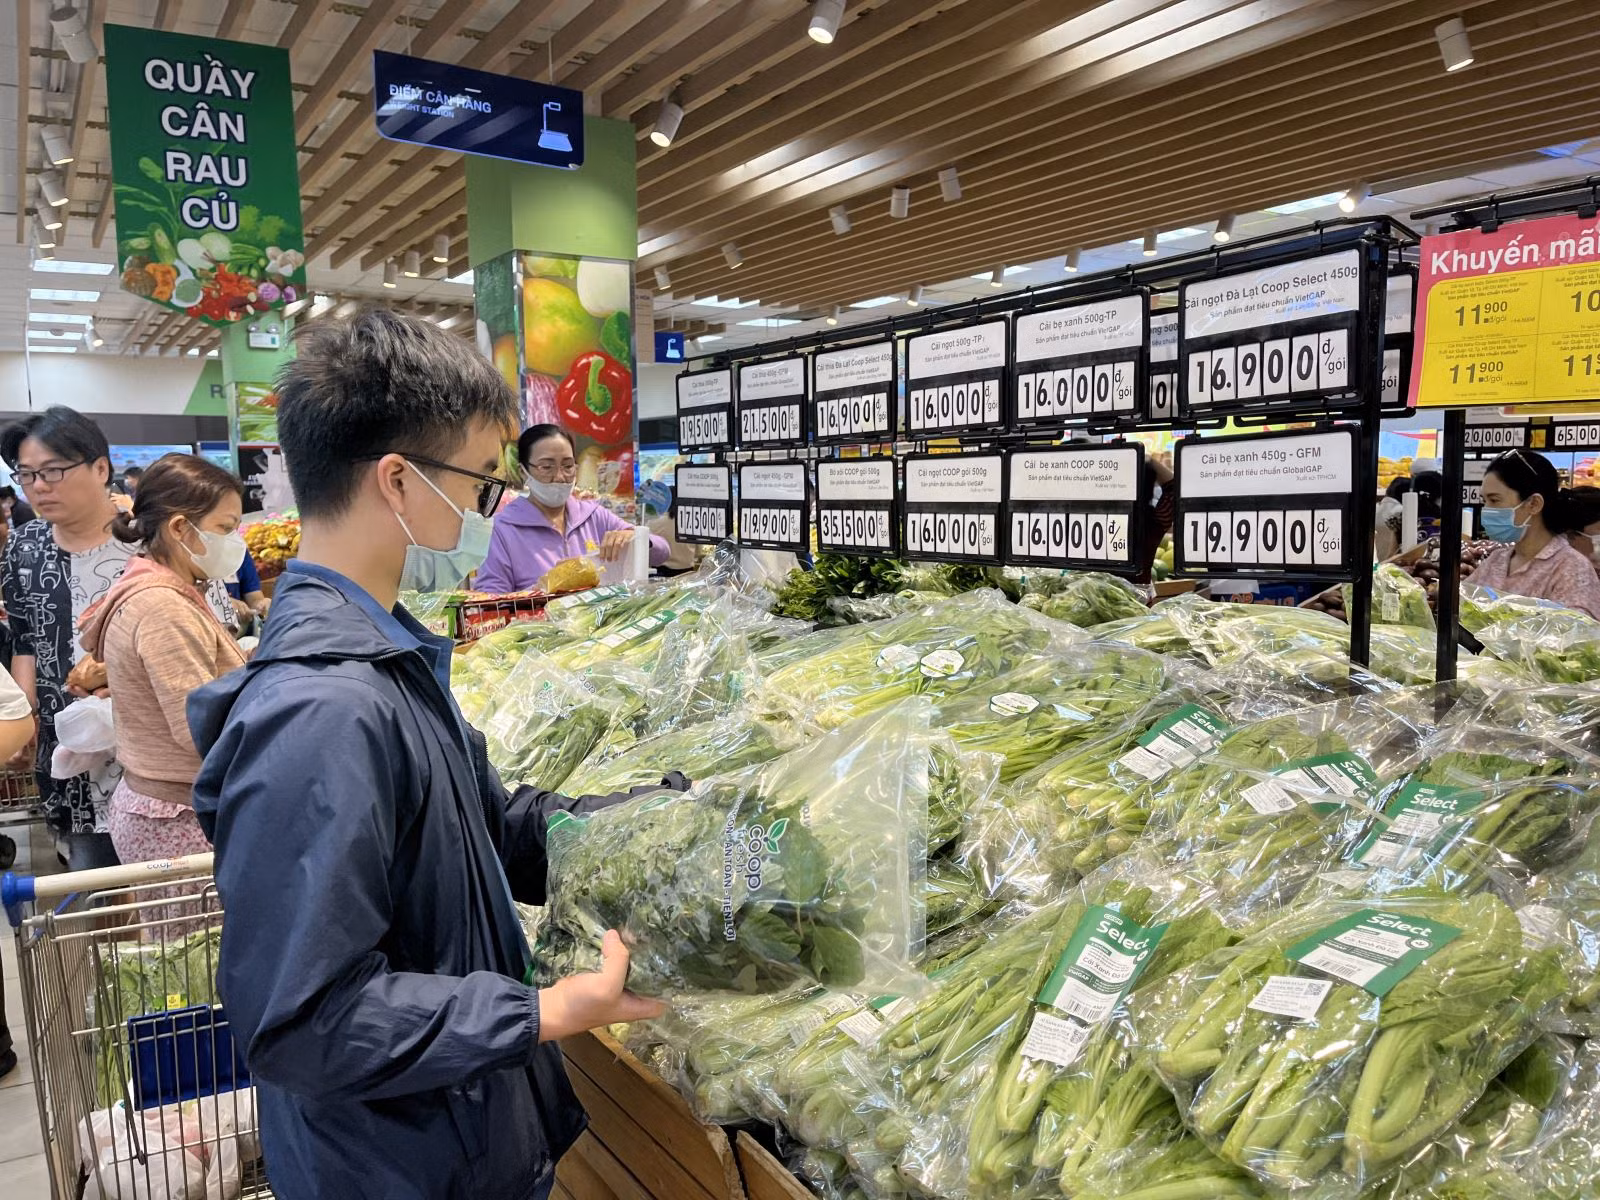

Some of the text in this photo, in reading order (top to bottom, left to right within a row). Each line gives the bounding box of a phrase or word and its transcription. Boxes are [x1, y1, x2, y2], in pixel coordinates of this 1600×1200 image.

[144, 53, 255, 99] QUẦY
[425, 91, 453, 106] CÂN
[161, 102, 245, 142] CÂN
[165, 151, 247, 187] RAU
[181, 192, 239, 230] CỦ
[1431, 234, 1539, 275] Khuyến
[1184, 266, 1358, 310] Cải ngọt Đà Lạt Coop Select 450g
[1223, 305, 1243, 317] phẩm
[1271, 296, 1294, 308] chuẩn
[1295, 290, 1326, 303] VietGAP
[1039, 310, 1117, 331] Cải bẹ xanh 500g-TP
[1098, 325, 1120, 336] VietGAP
[941, 341, 955, 350] ngọt
[956, 337, 971, 347] 500g
[1197, 345, 1314, 393] 16.900
[1024, 372, 1109, 409] 16.000
[820, 400, 870, 429] 16.900
[915, 389, 980, 421] 16.000
[682, 417, 718, 439] 19.500
[743, 410, 787, 434] 21.500
[1464, 430, 1512, 443] 20.000
[1024, 459, 1119, 471] Cải bẹ xanh COOP 500g
[1201, 453, 1217, 465] Cải
[1219, 452, 1232, 466] bẹ
[1234, 451, 1259, 463] xanh
[1261, 450, 1287, 462] 450g
[1296, 447, 1322, 458] GFM
[844, 467, 860, 476] COOP
[918, 467, 987, 479] Cải ngọt COOP gói 500g
[1200, 465, 1322, 479] Sản phẩm đạt tiêu chuẩn GlobalGAP
[679, 510, 716, 531] 17.500
[743, 513, 788, 535] 19.900
[822, 515, 876, 539] 35.500
[911, 518, 977, 547] 16.000
[1017, 518, 1104, 551] 16.000
[1191, 518, 1306, 554] 19.900
[1340, 760, 1377, 792] Select
[1410, 793, 1458, 810] Select
[736, 829, 747, 873] fresh
[744, 825, 764, 889] co.op
[1366, 915, 1432, 937] Select
